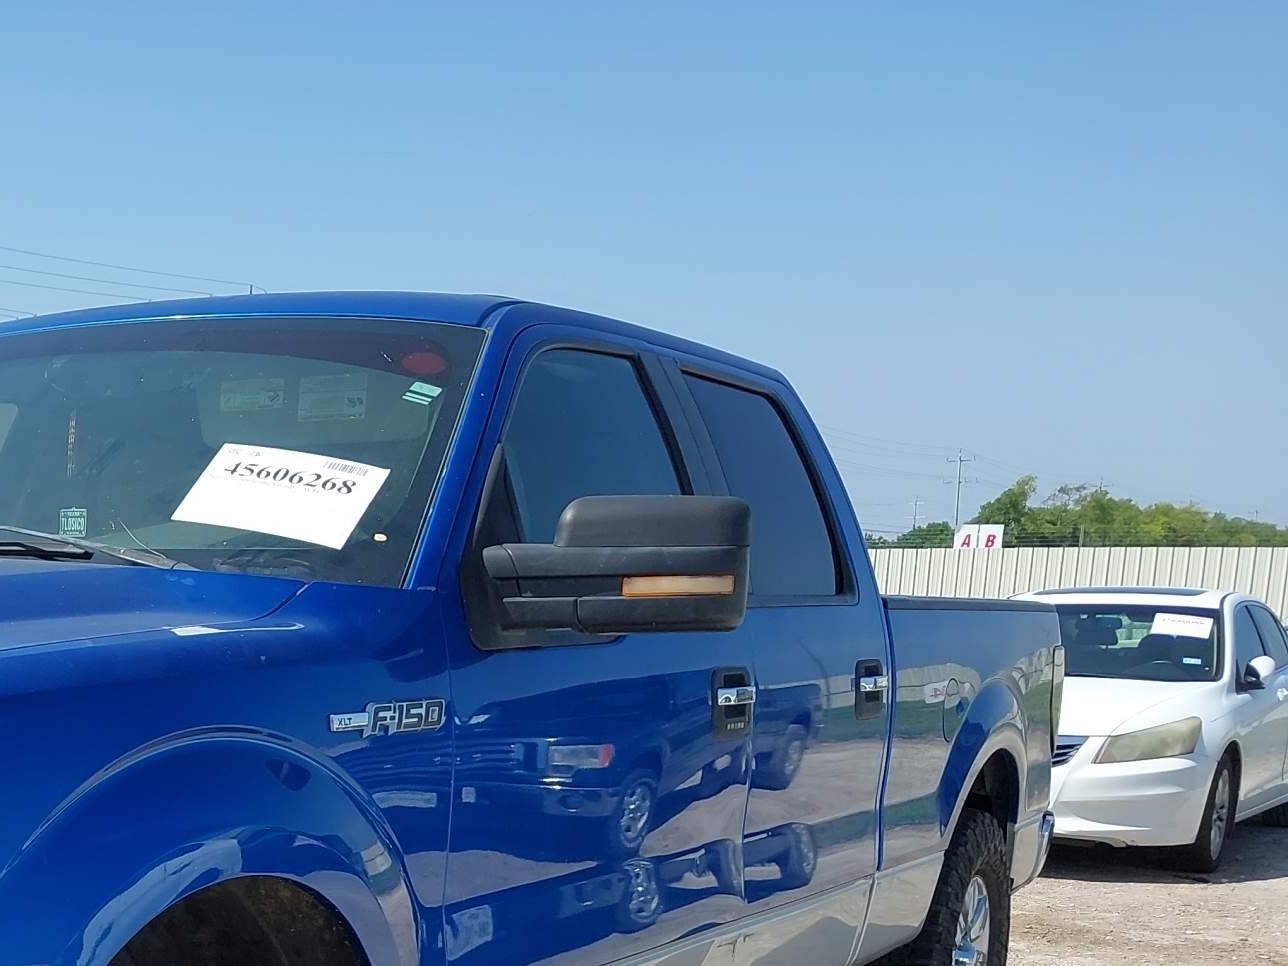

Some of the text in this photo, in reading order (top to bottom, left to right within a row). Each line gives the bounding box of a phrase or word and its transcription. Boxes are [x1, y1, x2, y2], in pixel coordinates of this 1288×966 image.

[224, 461, 357, 495] 45606268
[961, 533, 971, 548] A
[985, 534, 997, 548] B
[337, 717, 352, 727] XLT
[367, 700, 445, 733] F-150
